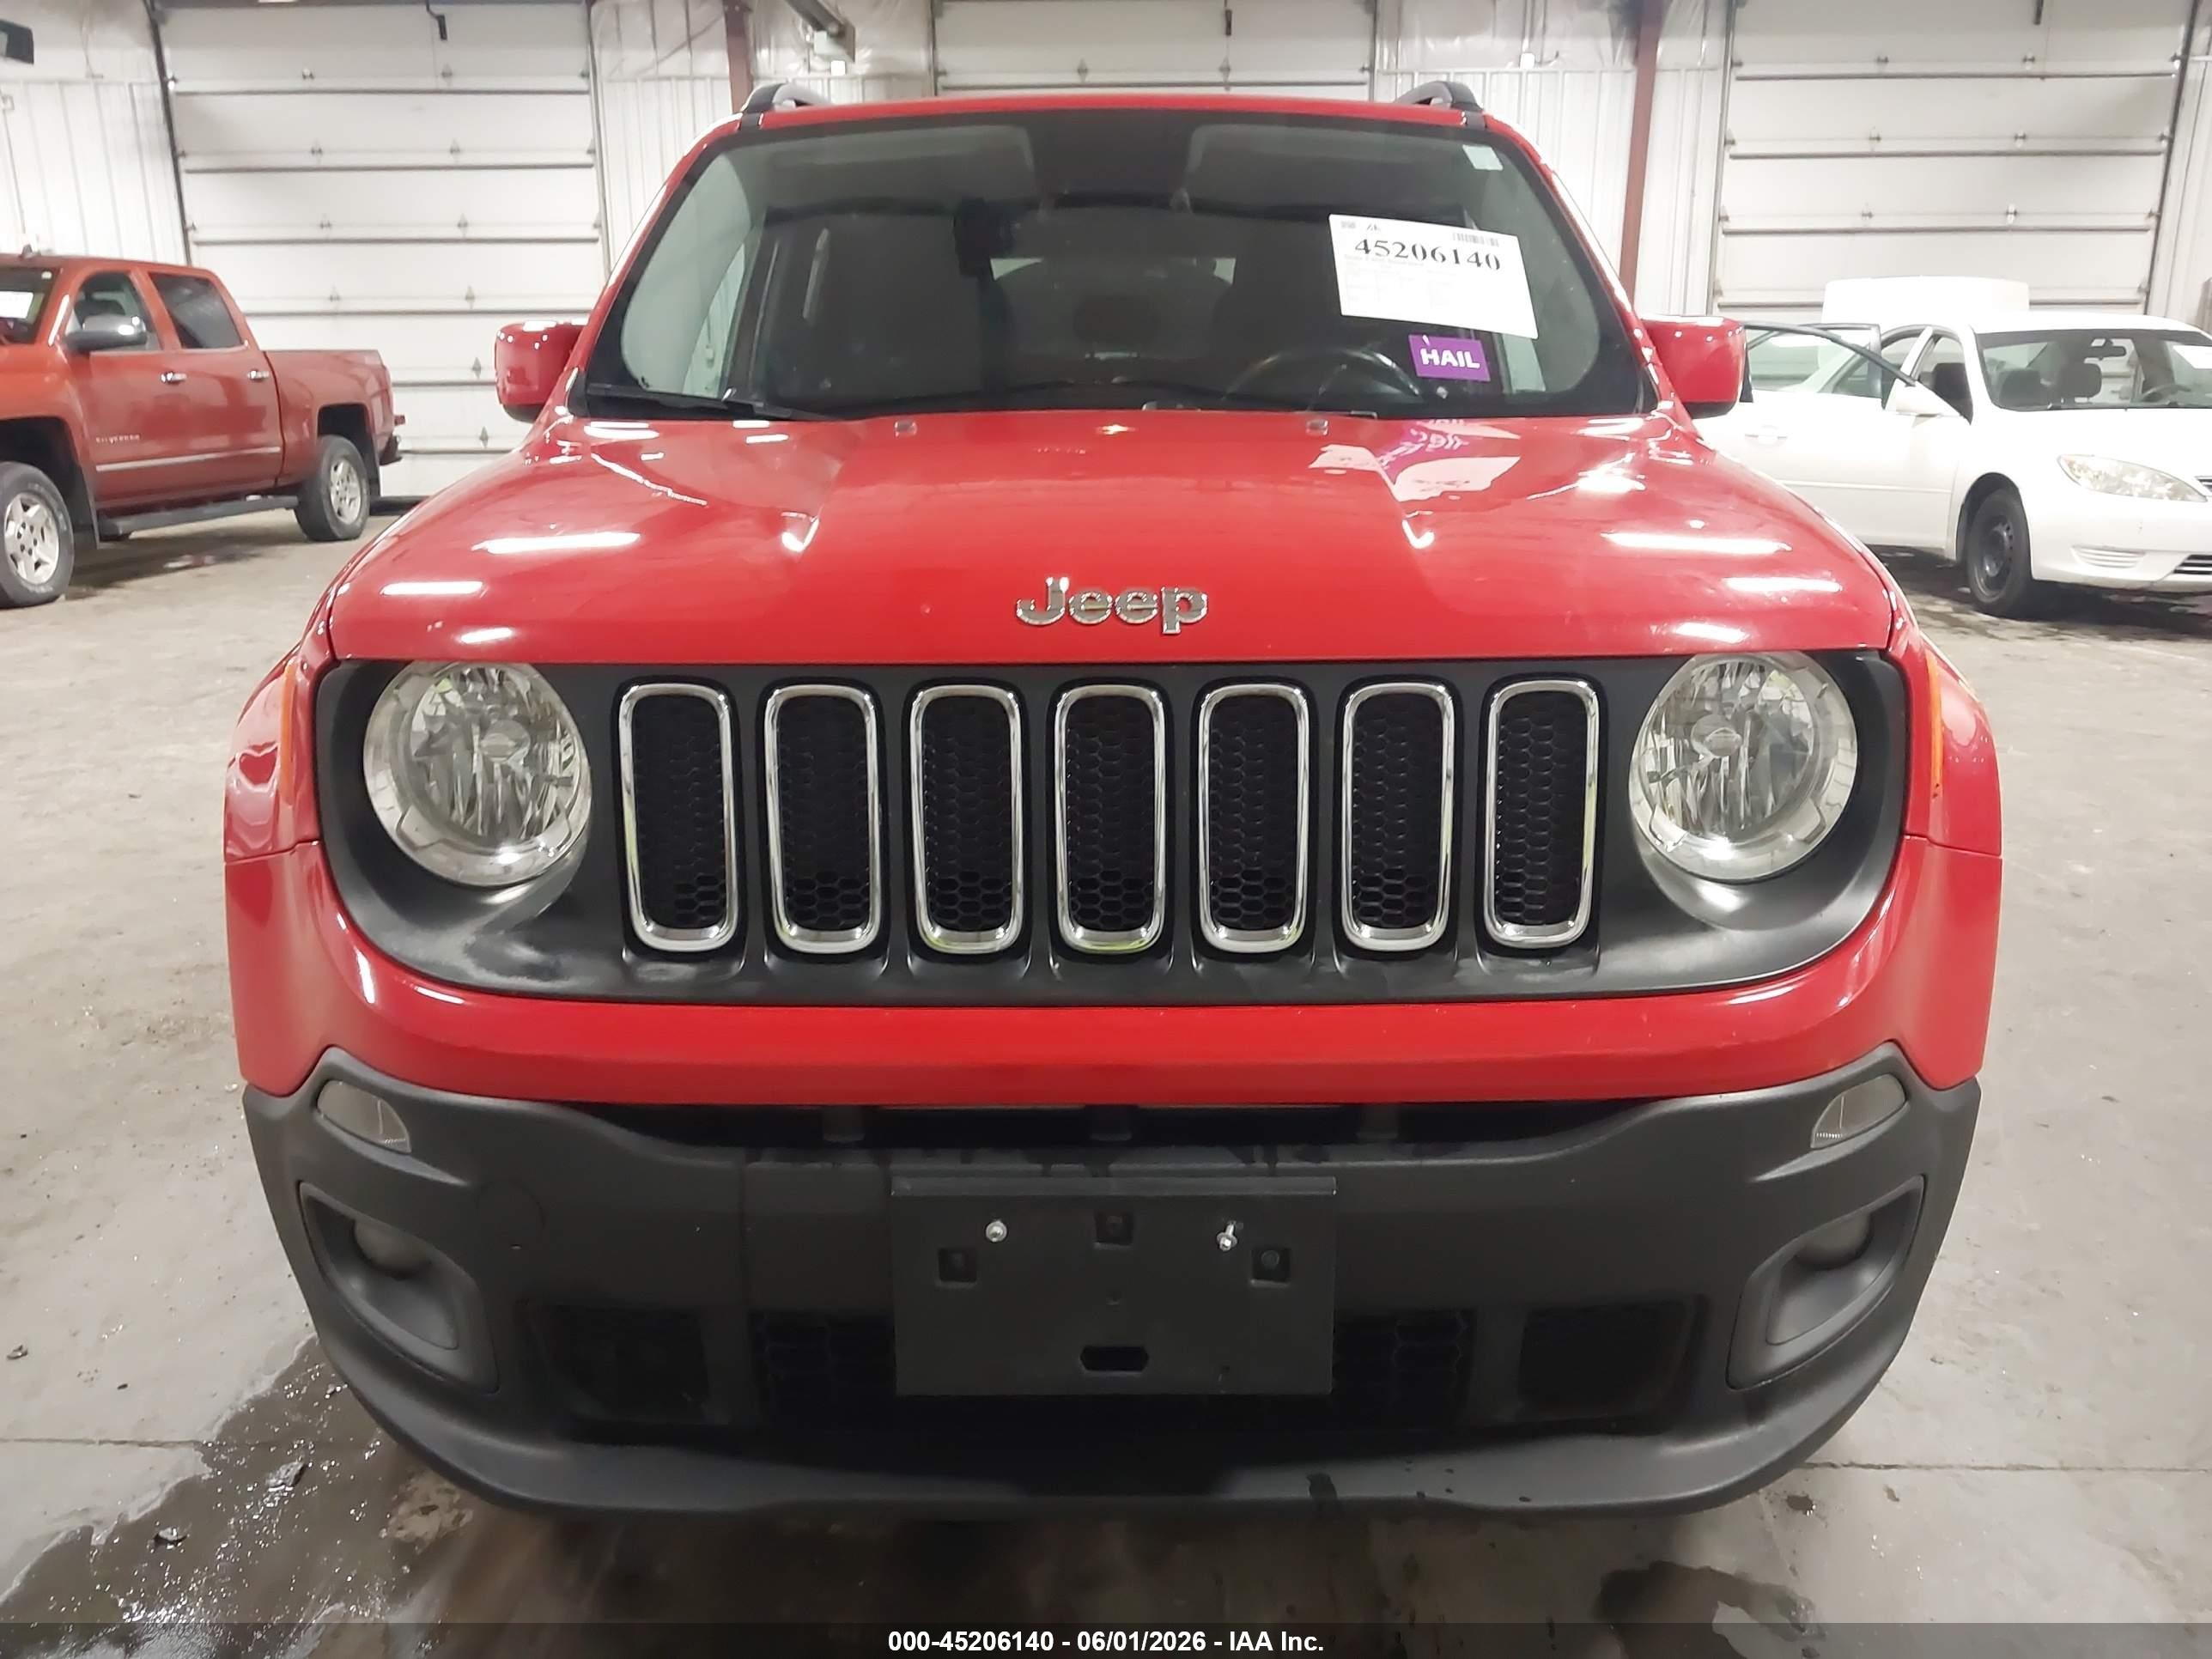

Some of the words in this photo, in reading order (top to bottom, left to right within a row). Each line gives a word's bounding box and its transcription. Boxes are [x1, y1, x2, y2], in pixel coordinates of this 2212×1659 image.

[1354, 238, 1501, 271] 45206140
[1419, 348, 1480, 369] HAIL
[1016, 576, 1208, 635] Jeep
